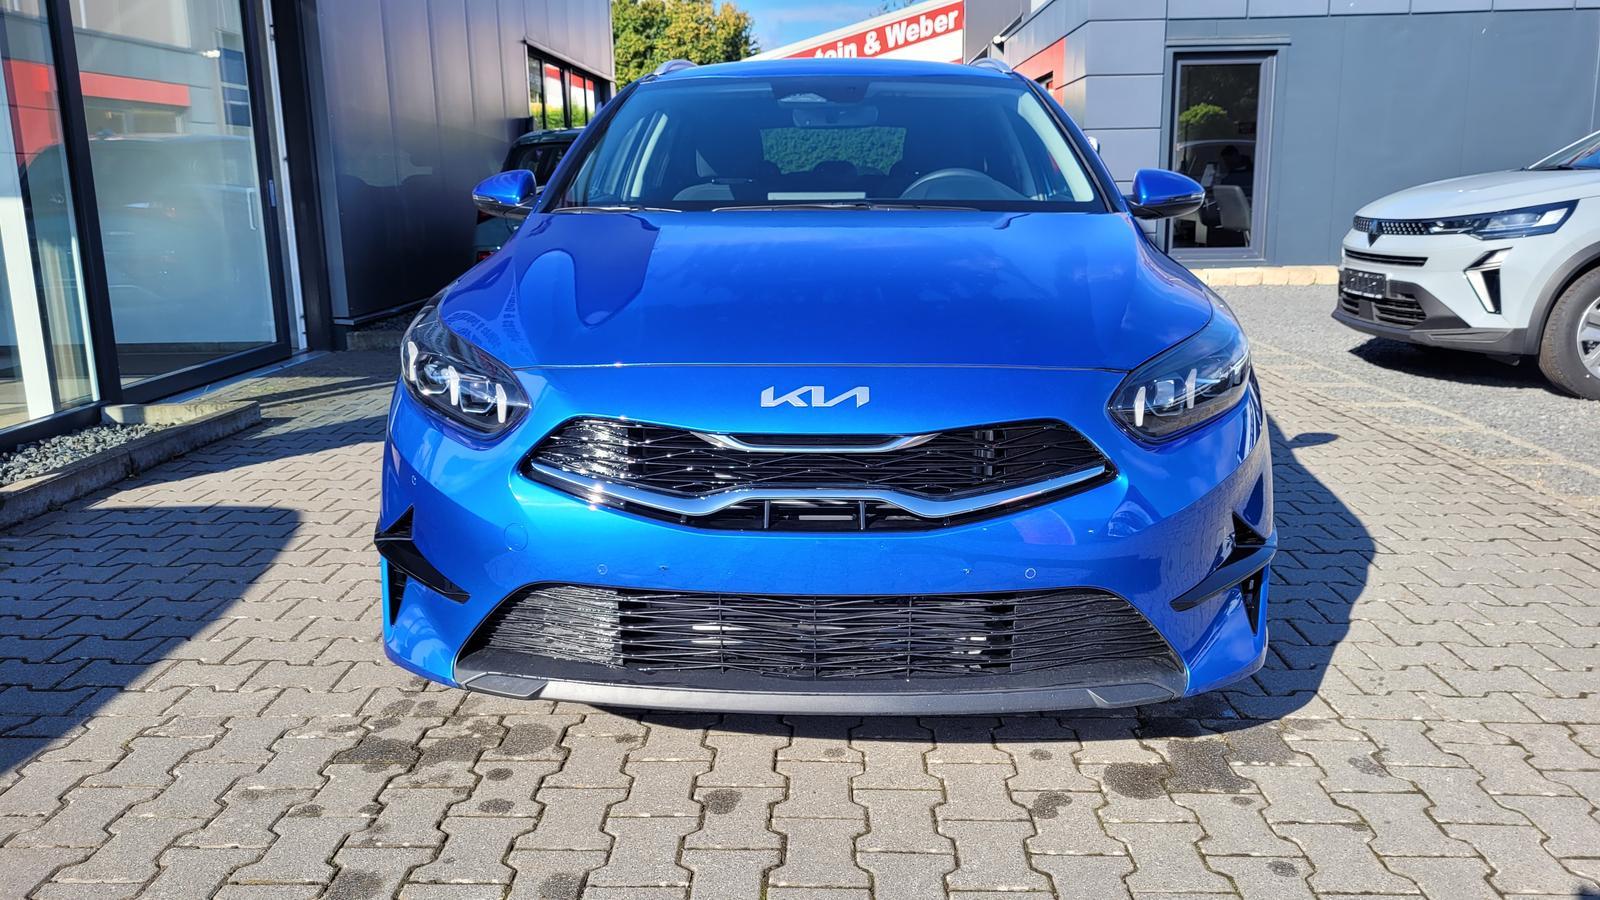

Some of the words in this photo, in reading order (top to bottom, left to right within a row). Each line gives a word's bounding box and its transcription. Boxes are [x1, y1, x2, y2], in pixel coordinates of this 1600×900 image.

[864, 31, 881, 55] &
[885, 10, 959, 48] Weber
[761, 386, 869, 408] KIA
